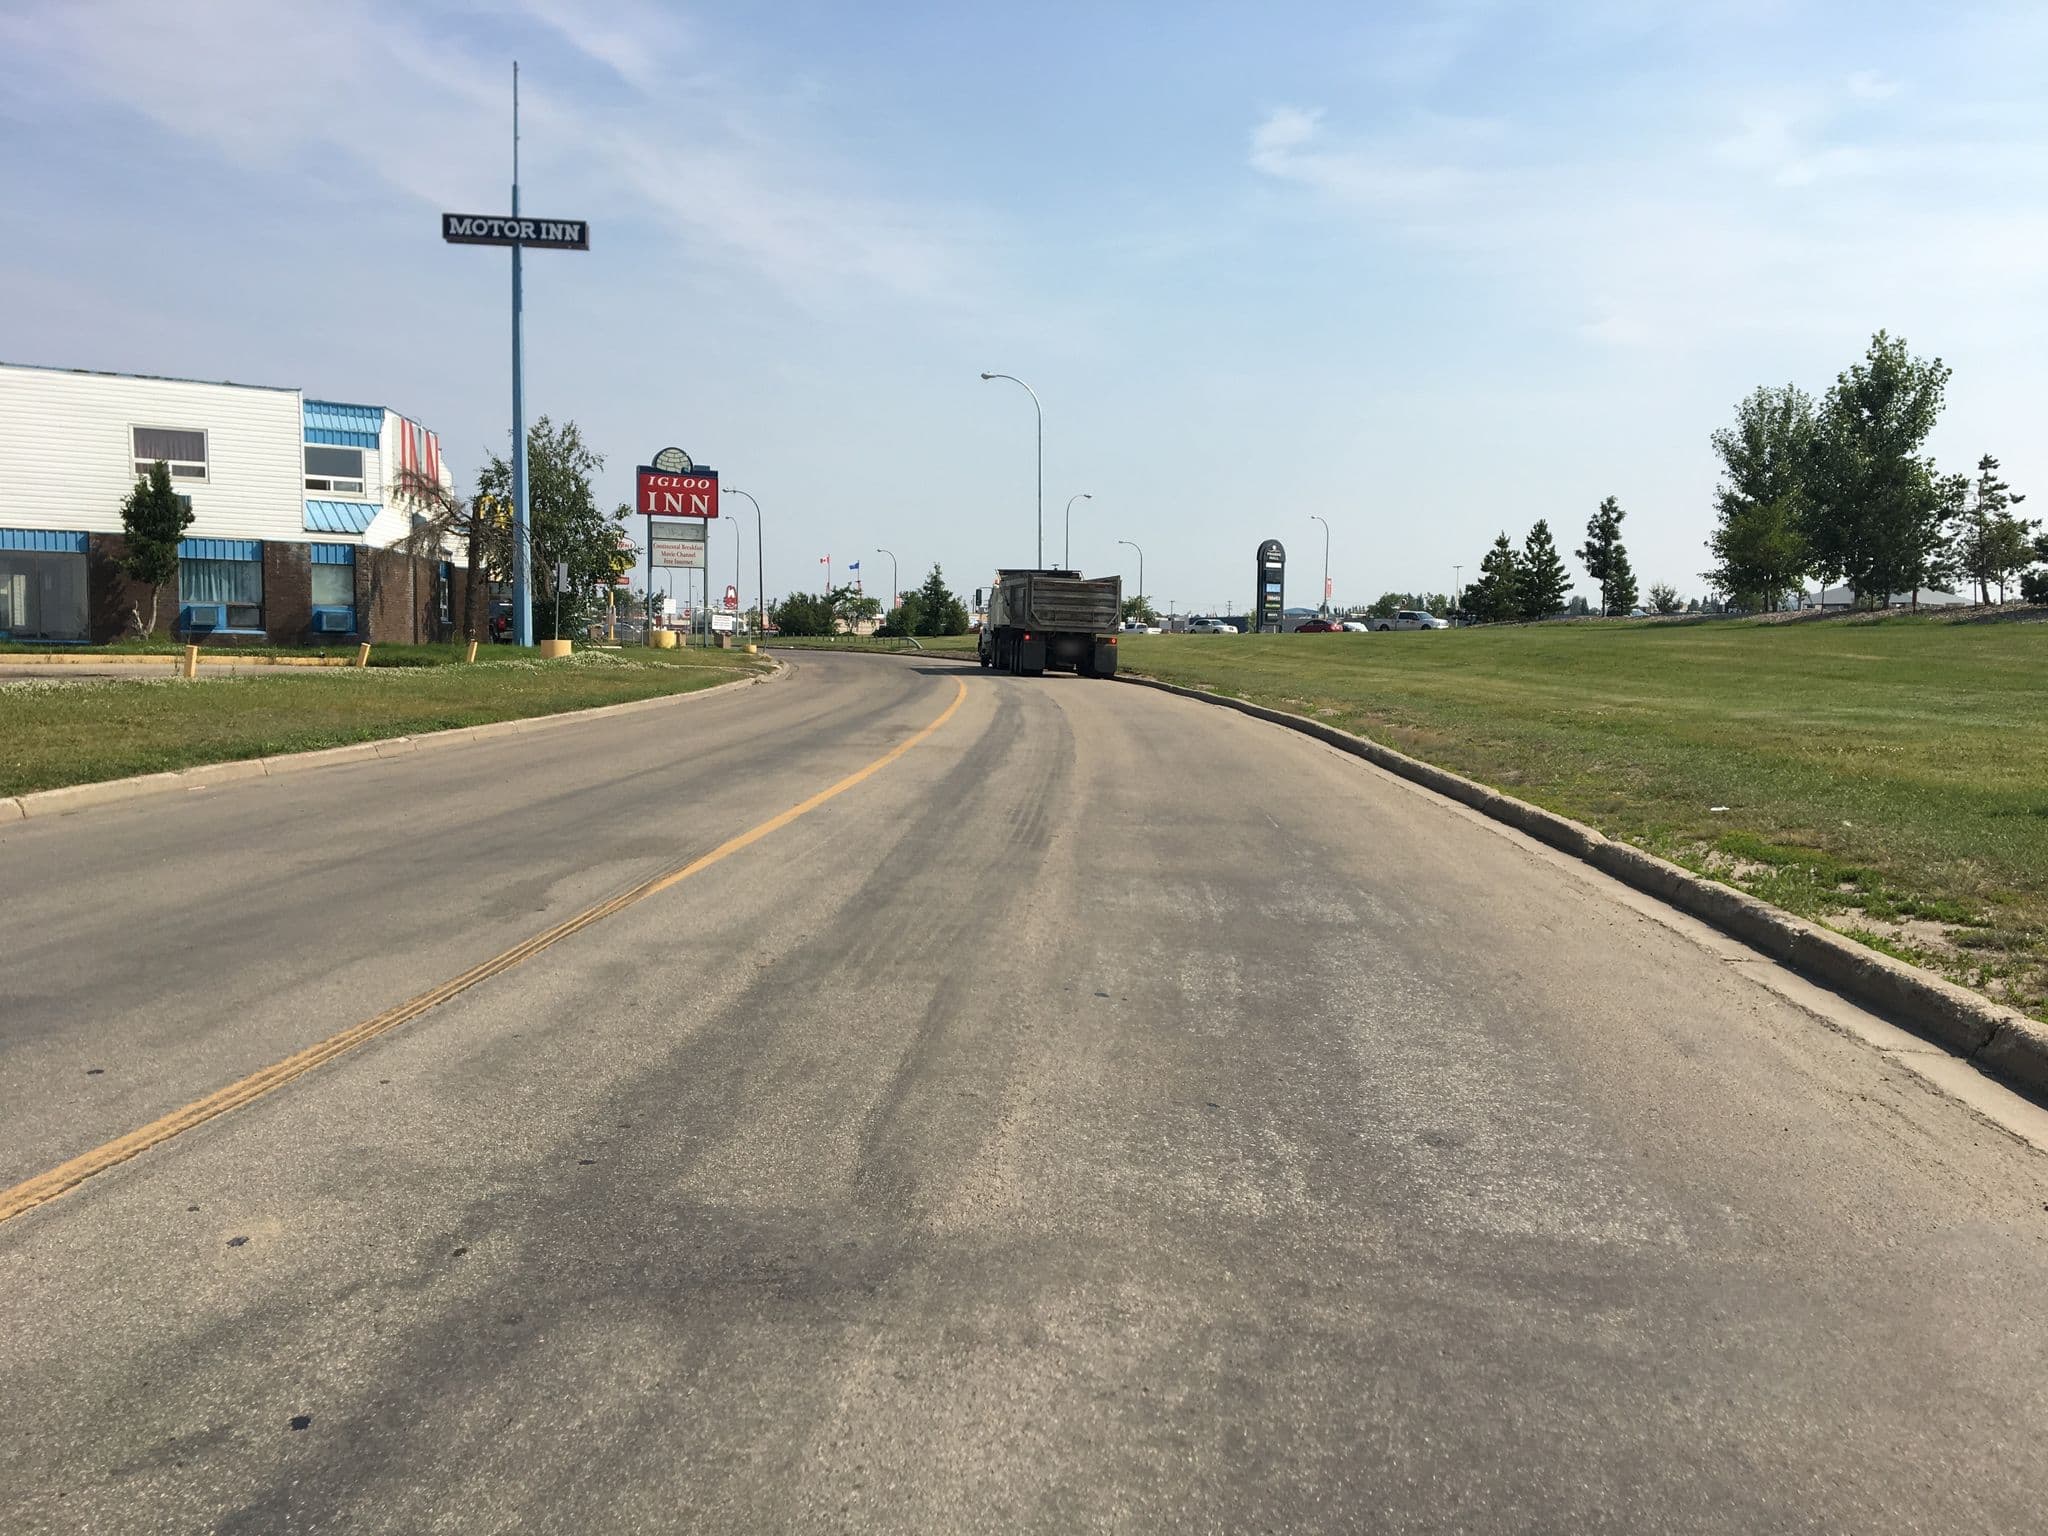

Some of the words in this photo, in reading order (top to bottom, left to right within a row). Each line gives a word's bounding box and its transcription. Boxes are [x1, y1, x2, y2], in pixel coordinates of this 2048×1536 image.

[449, 217, 536, 238] MOTOR
[540, 222, 580, 241] INN
[648, 476, 710, 489] IGLOO
[647, 491, 710, 515] INN
